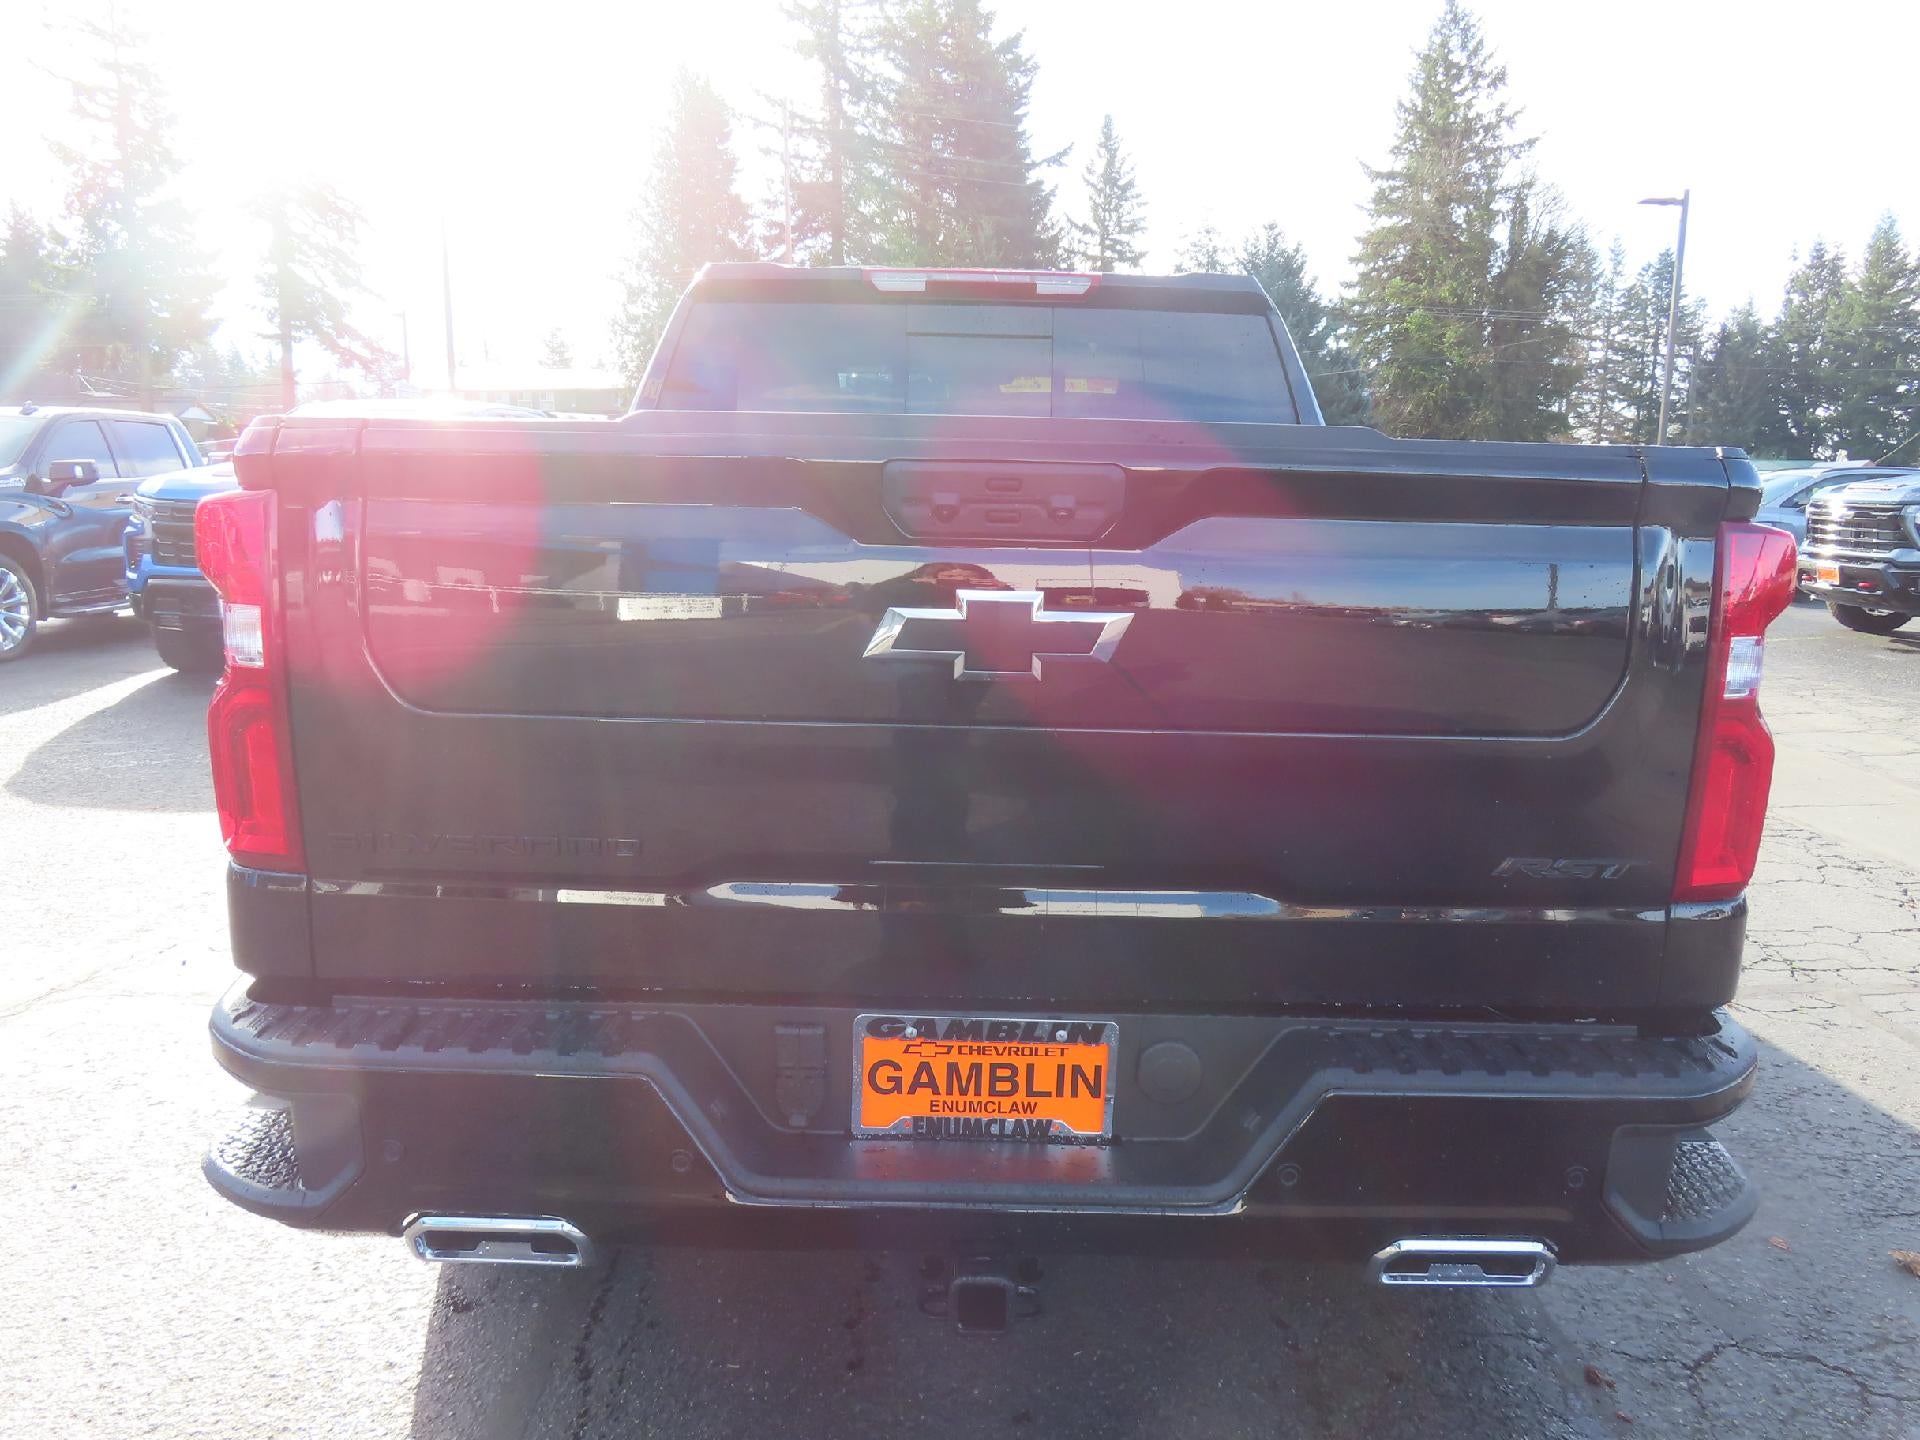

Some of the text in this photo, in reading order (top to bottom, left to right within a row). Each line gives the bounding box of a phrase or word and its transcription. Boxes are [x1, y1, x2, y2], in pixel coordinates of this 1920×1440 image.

[1491, 857, 1649, 879] RST
[866, 1016, 1107, 1044] GAMBLIN
[957, 1045, 1070, 1057] CHEVROLET
[867, 1059, 1103, 1099] GAMBLIN
[929, 1100, 1038, 1114] ENUMCLAW
[912, 1116, 1053, 1137] ENUMCLAW
